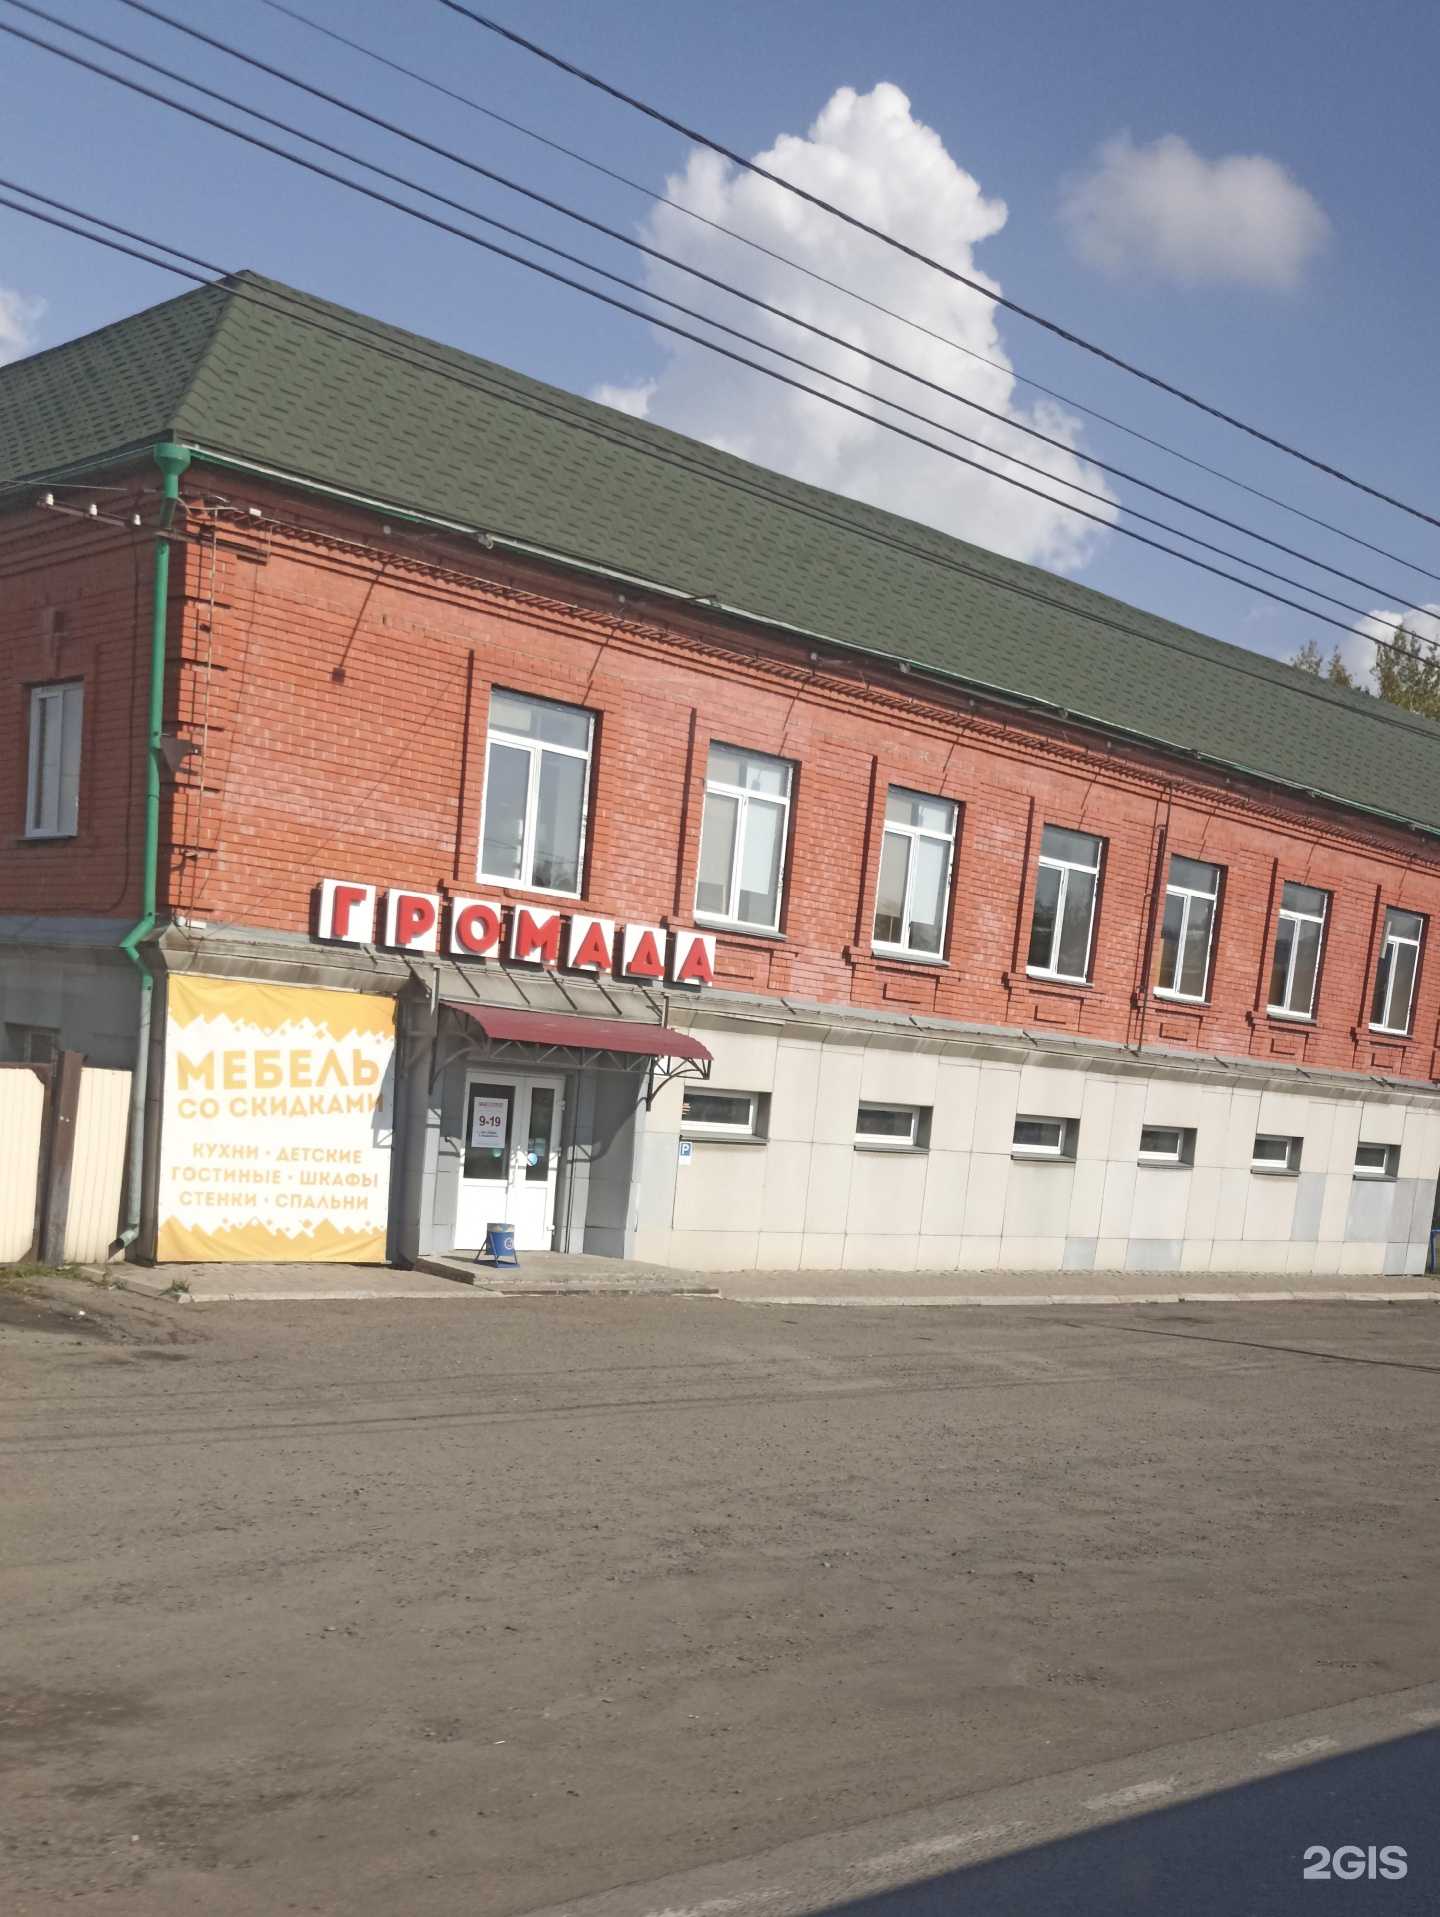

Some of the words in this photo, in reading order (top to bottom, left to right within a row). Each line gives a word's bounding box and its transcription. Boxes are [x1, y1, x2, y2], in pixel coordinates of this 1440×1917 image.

[331, 885, 714, 984] ГРОМАДА
[176, 1048, 380, 1090] МЕБЕЛЬ
[177, 1098, 219, 1119] СО
[229, 1093, 384, 1117] СКИДКАМИ
[479, 1115, 501, 1127] 9-19
[192, 1143, 259, 1159] КУХНИ
[275, 1147, 363, 1164] ДЕТСКИЕ
[171, 1166, 281, 1185] ГОСТИНЫЕ
[299, 1169, 379, 1188] ШКАФЫ
[179, 1191, 257, 1207] СТЕНКИ
[275, 1193, 369, 1210] СПАЛЬНИ
